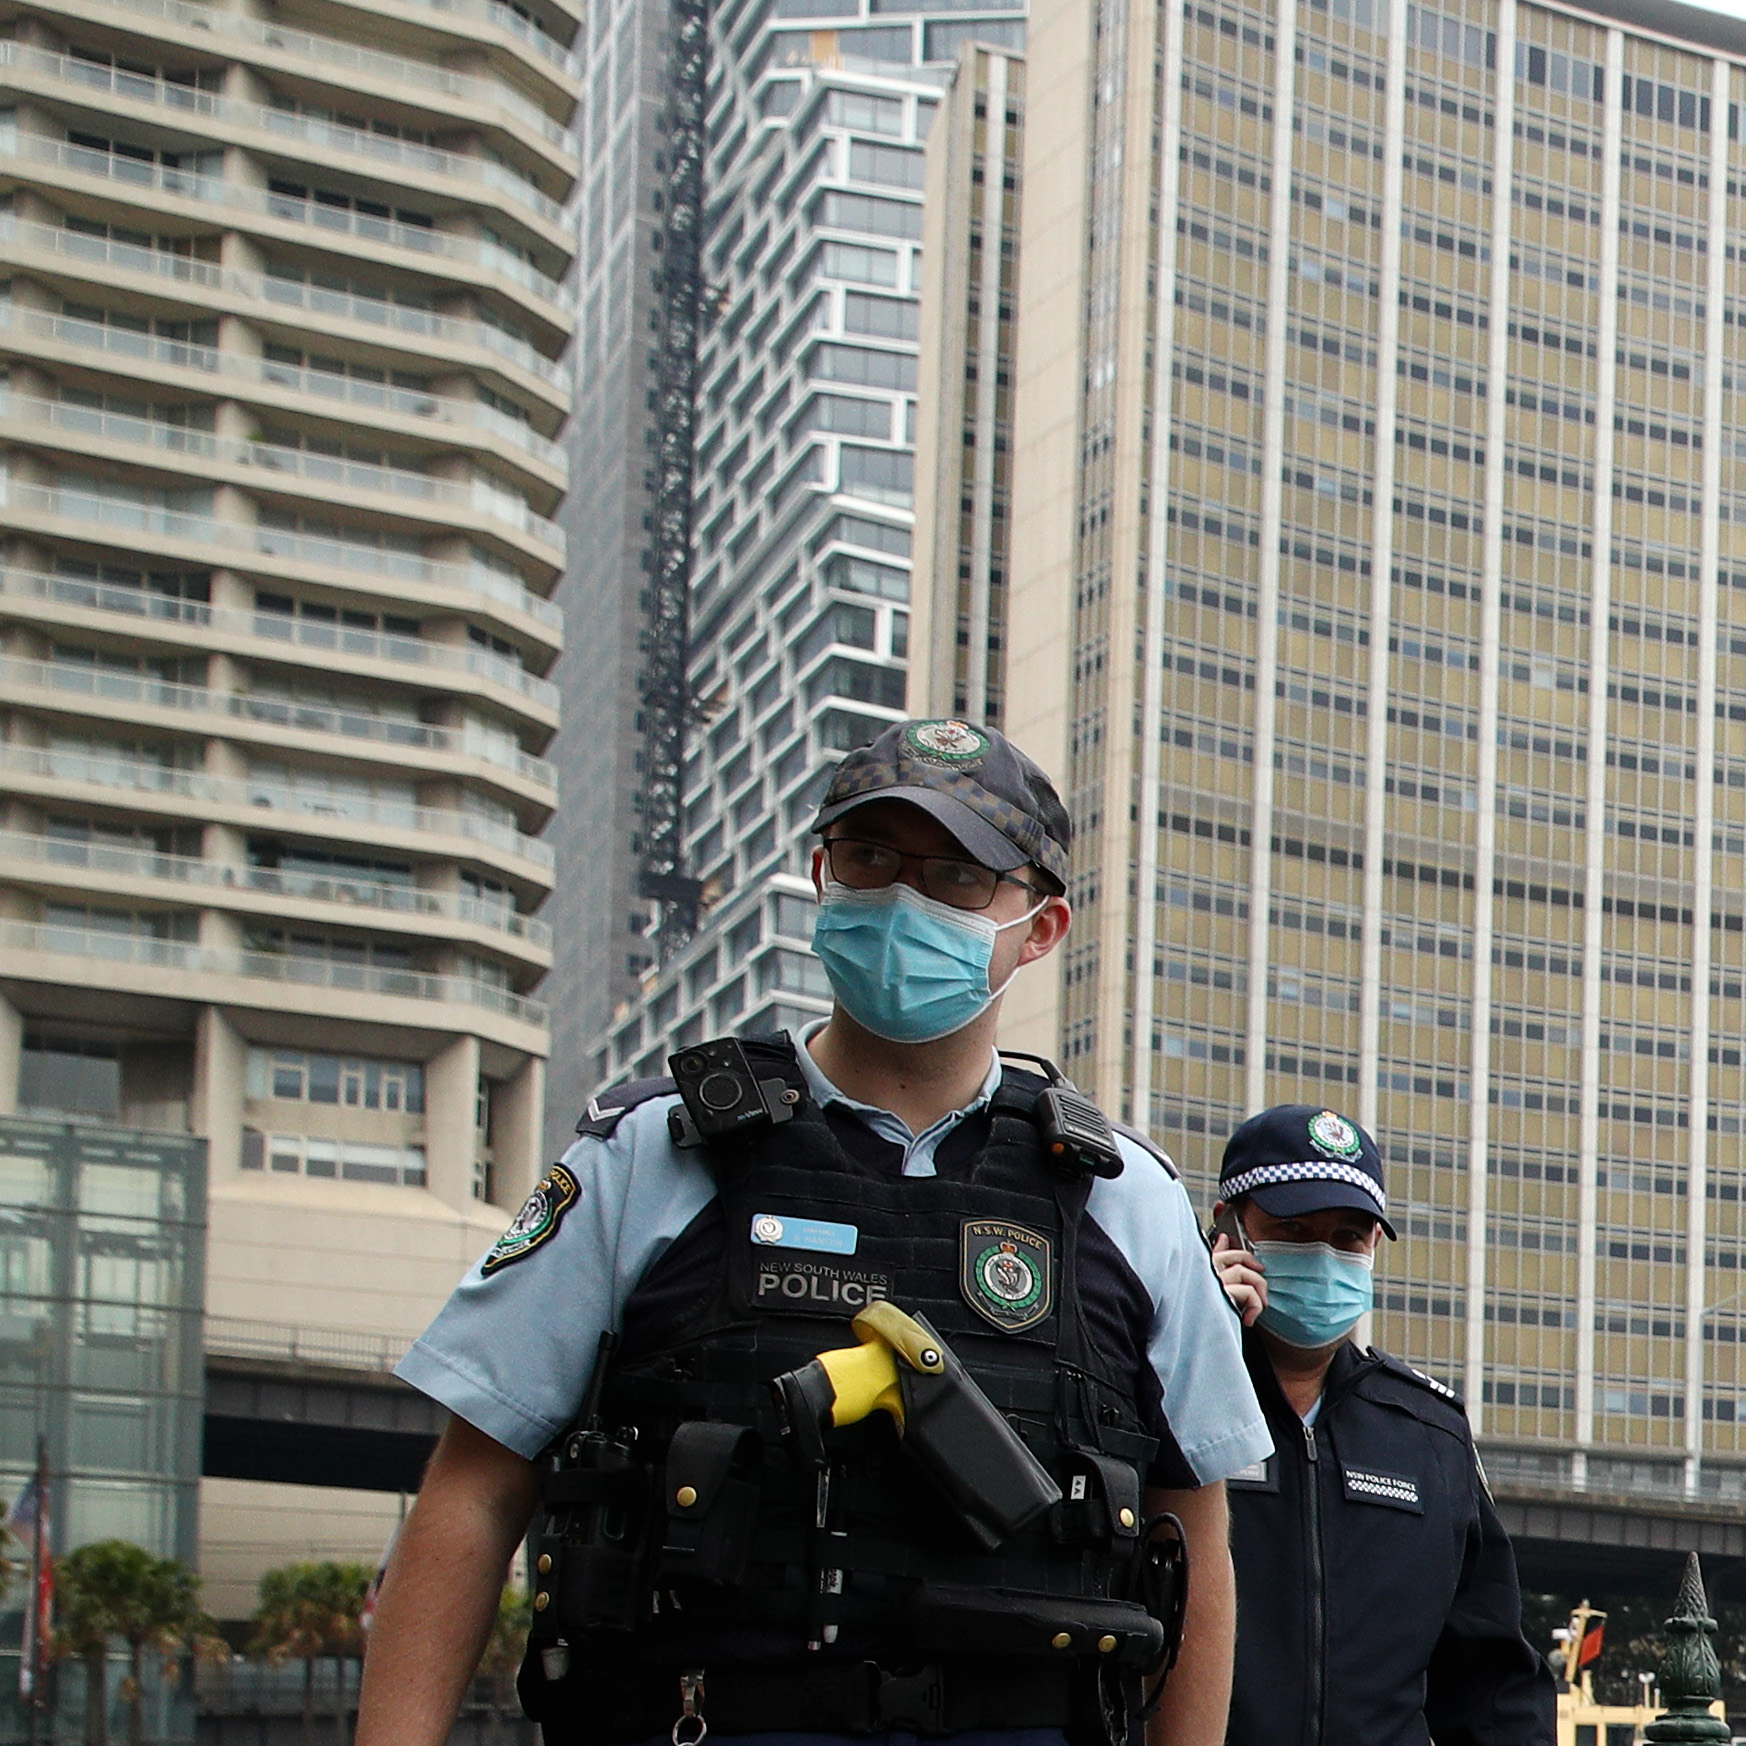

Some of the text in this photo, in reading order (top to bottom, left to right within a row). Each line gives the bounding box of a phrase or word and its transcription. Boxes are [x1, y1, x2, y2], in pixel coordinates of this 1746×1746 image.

[973, 1226, 1043, 1251] N.S.W. POLICE
[760, 1262, 888, 1285] NEW SOUTH WALES
[758, 1273, 888, 1306] POLICE
[1345, 1470, 1416, 1492] NSW POLICE FORCE
